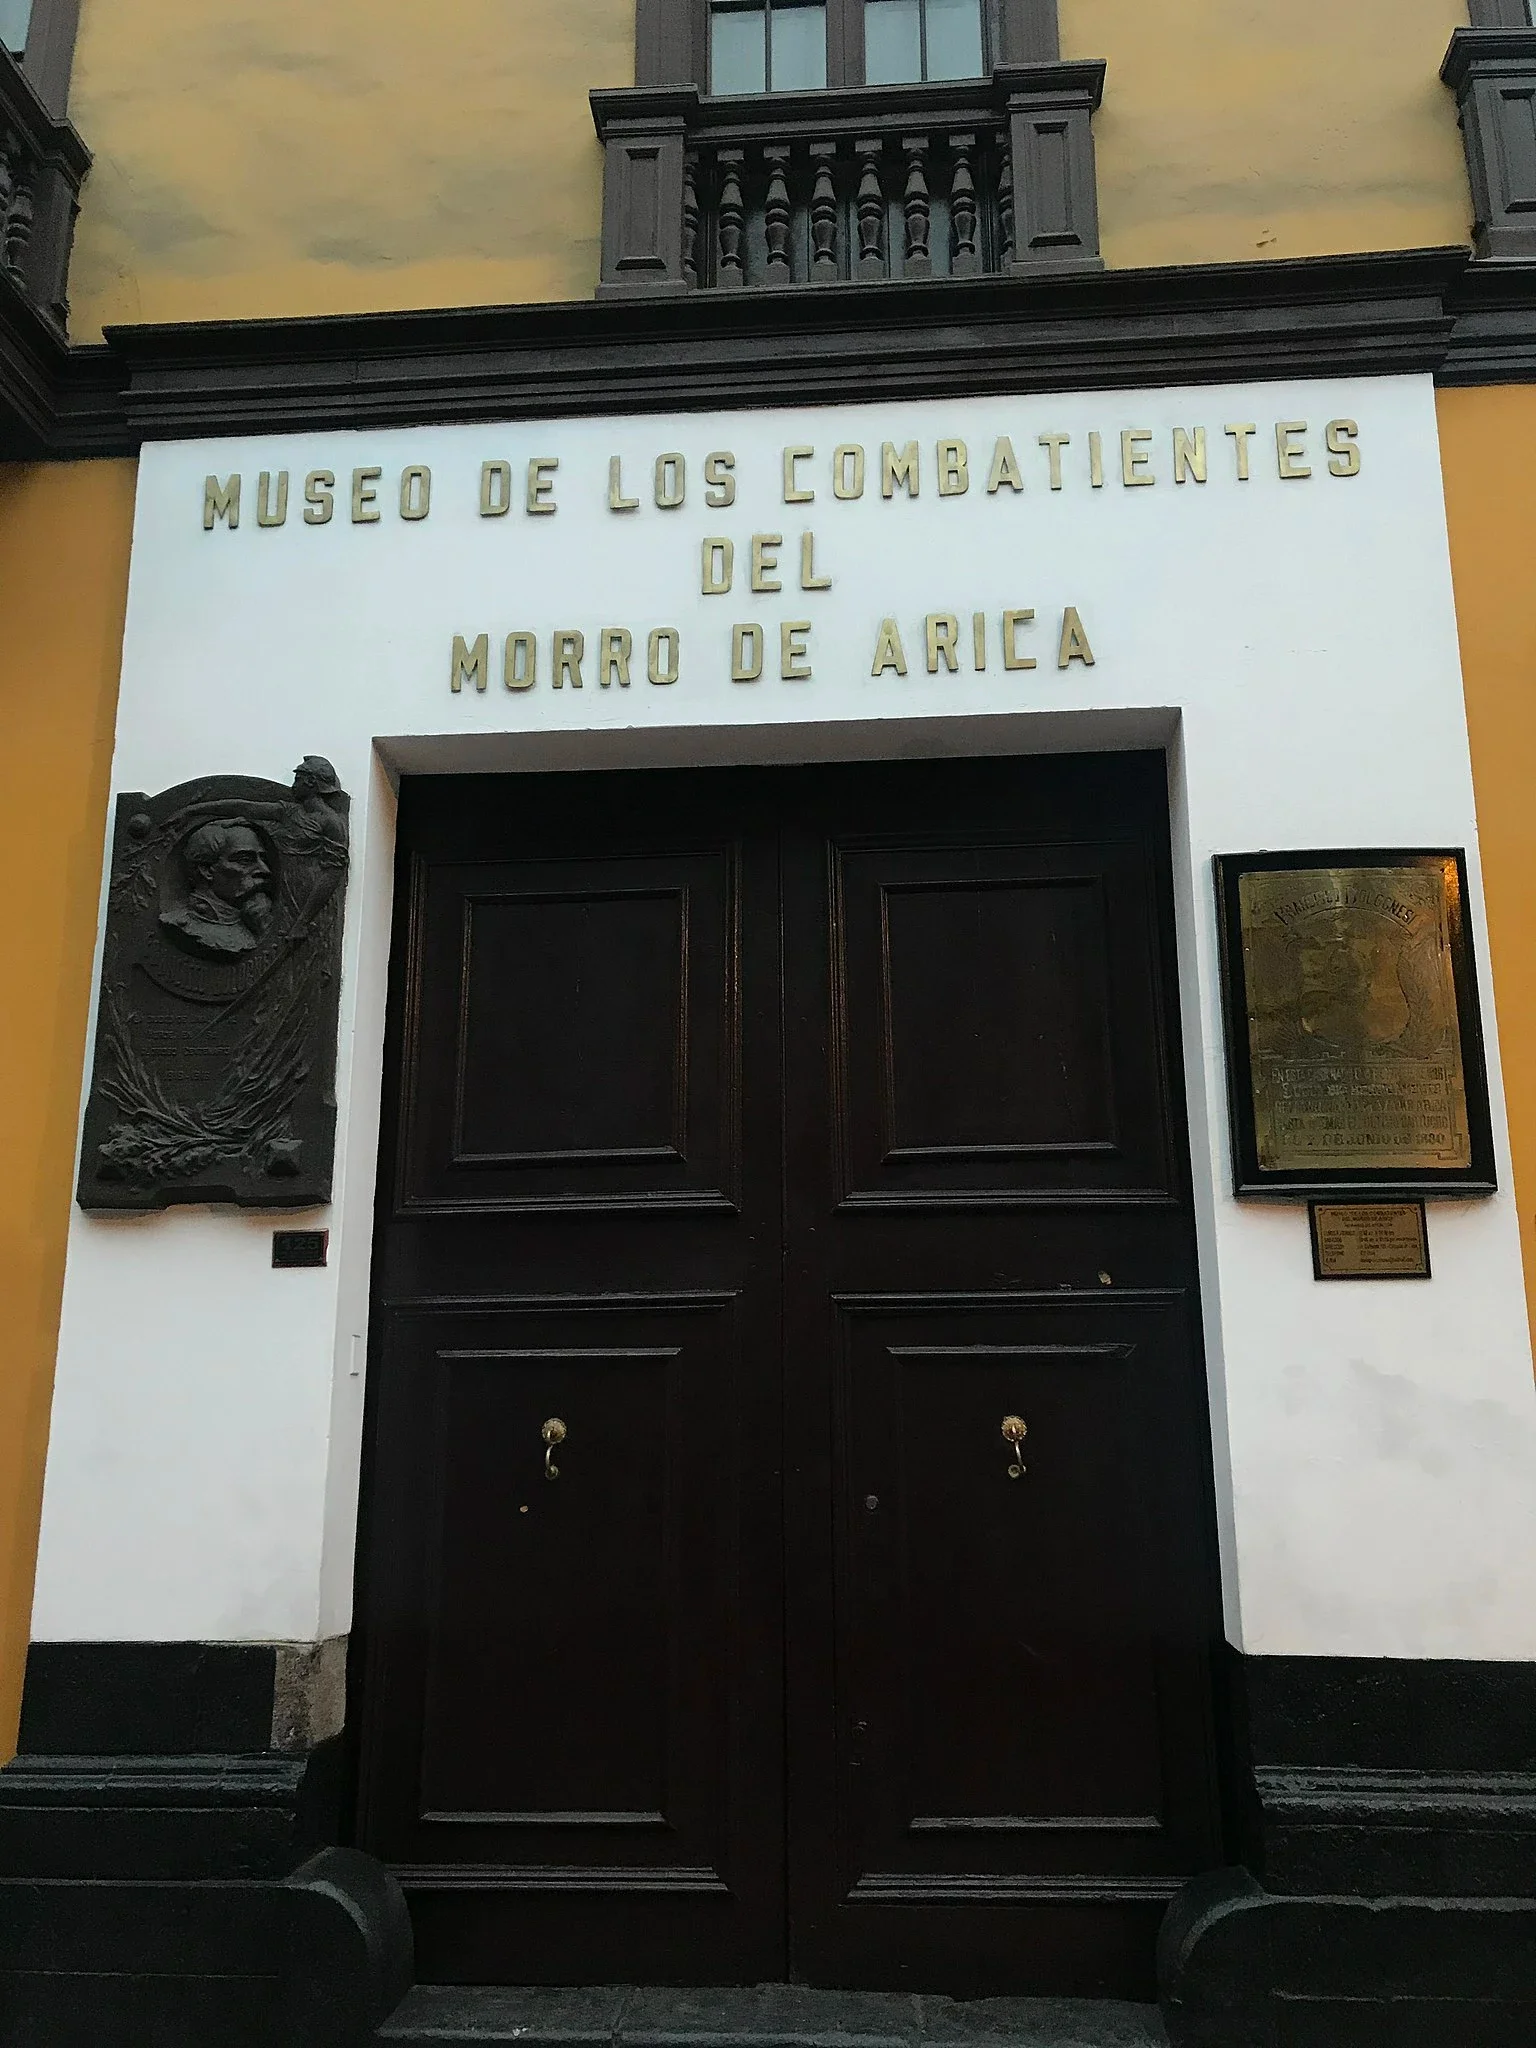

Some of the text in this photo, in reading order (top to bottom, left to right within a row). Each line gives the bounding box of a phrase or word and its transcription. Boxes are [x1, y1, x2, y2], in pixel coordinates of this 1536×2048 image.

[203, 418, 1361, 532] MUSEO DE LOS COMBATIENTES
[701, 531, 833, 596] DEL
[450, 606, 1096, 694] MORRO DE ARICA
